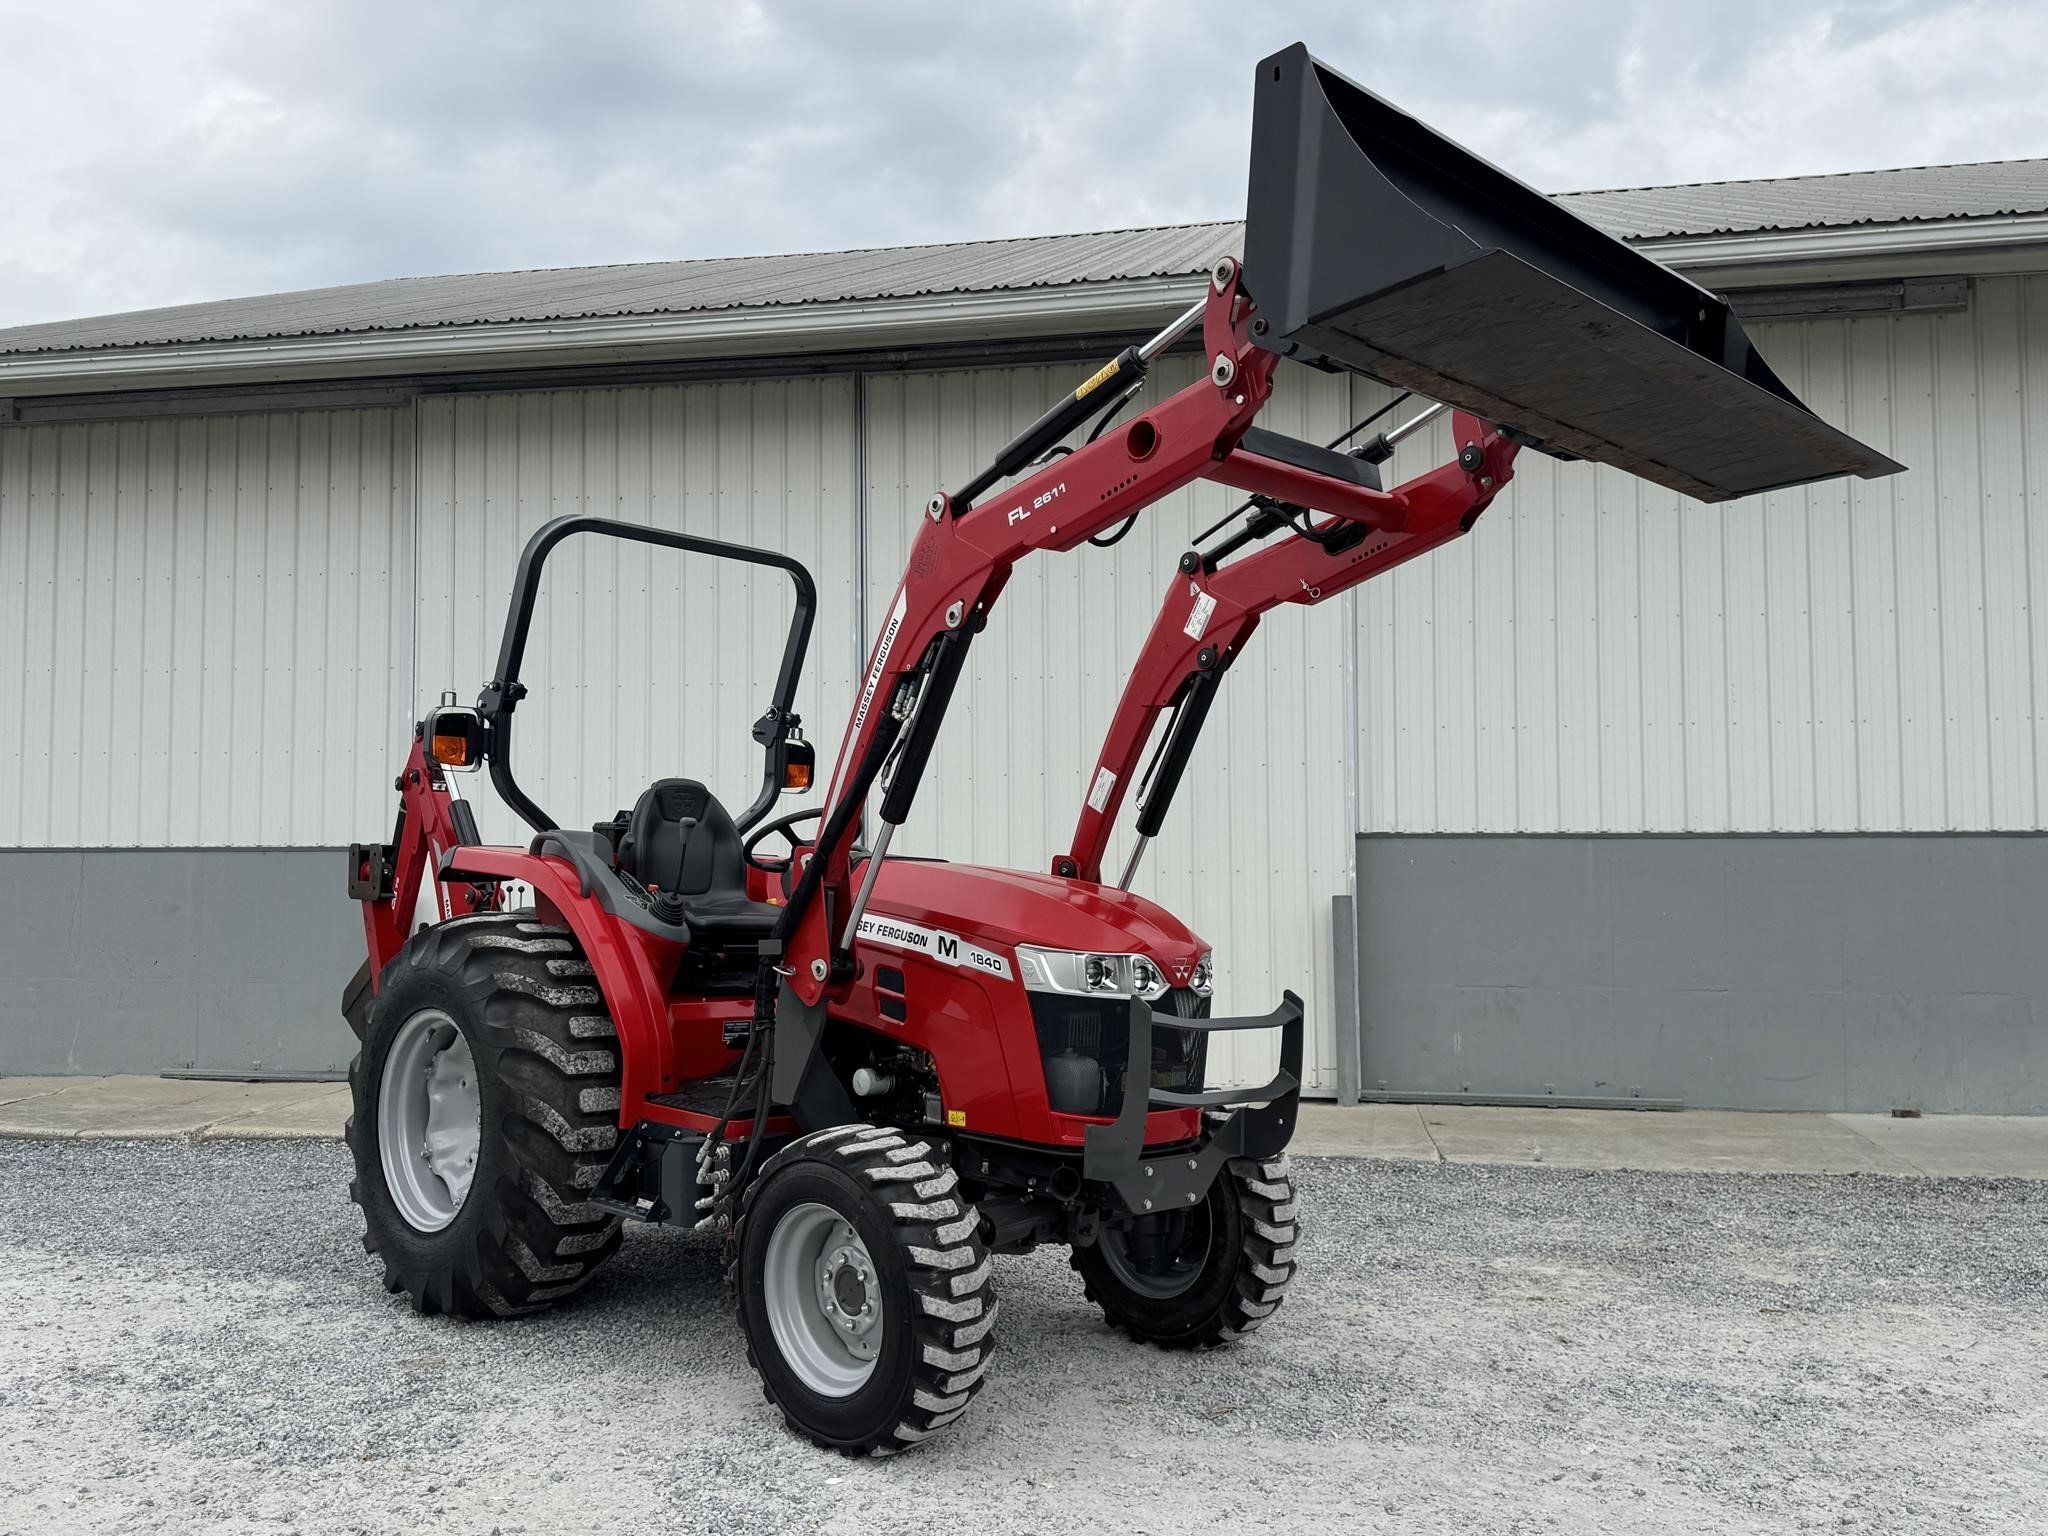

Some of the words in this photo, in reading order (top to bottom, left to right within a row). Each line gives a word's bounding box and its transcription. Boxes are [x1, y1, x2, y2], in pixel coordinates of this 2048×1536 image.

[1007, 505, 1031, 527] FL
[1033, 482, 1066, 510] 2611
[855, 681, 875, 729] MASSEY
[872, 618, 899, 680] FERGUSON
[876, 924, 929, 948] FERGUSON
[938, 935, 958, 959] M
[970, 952, 1002, 972] 1840
